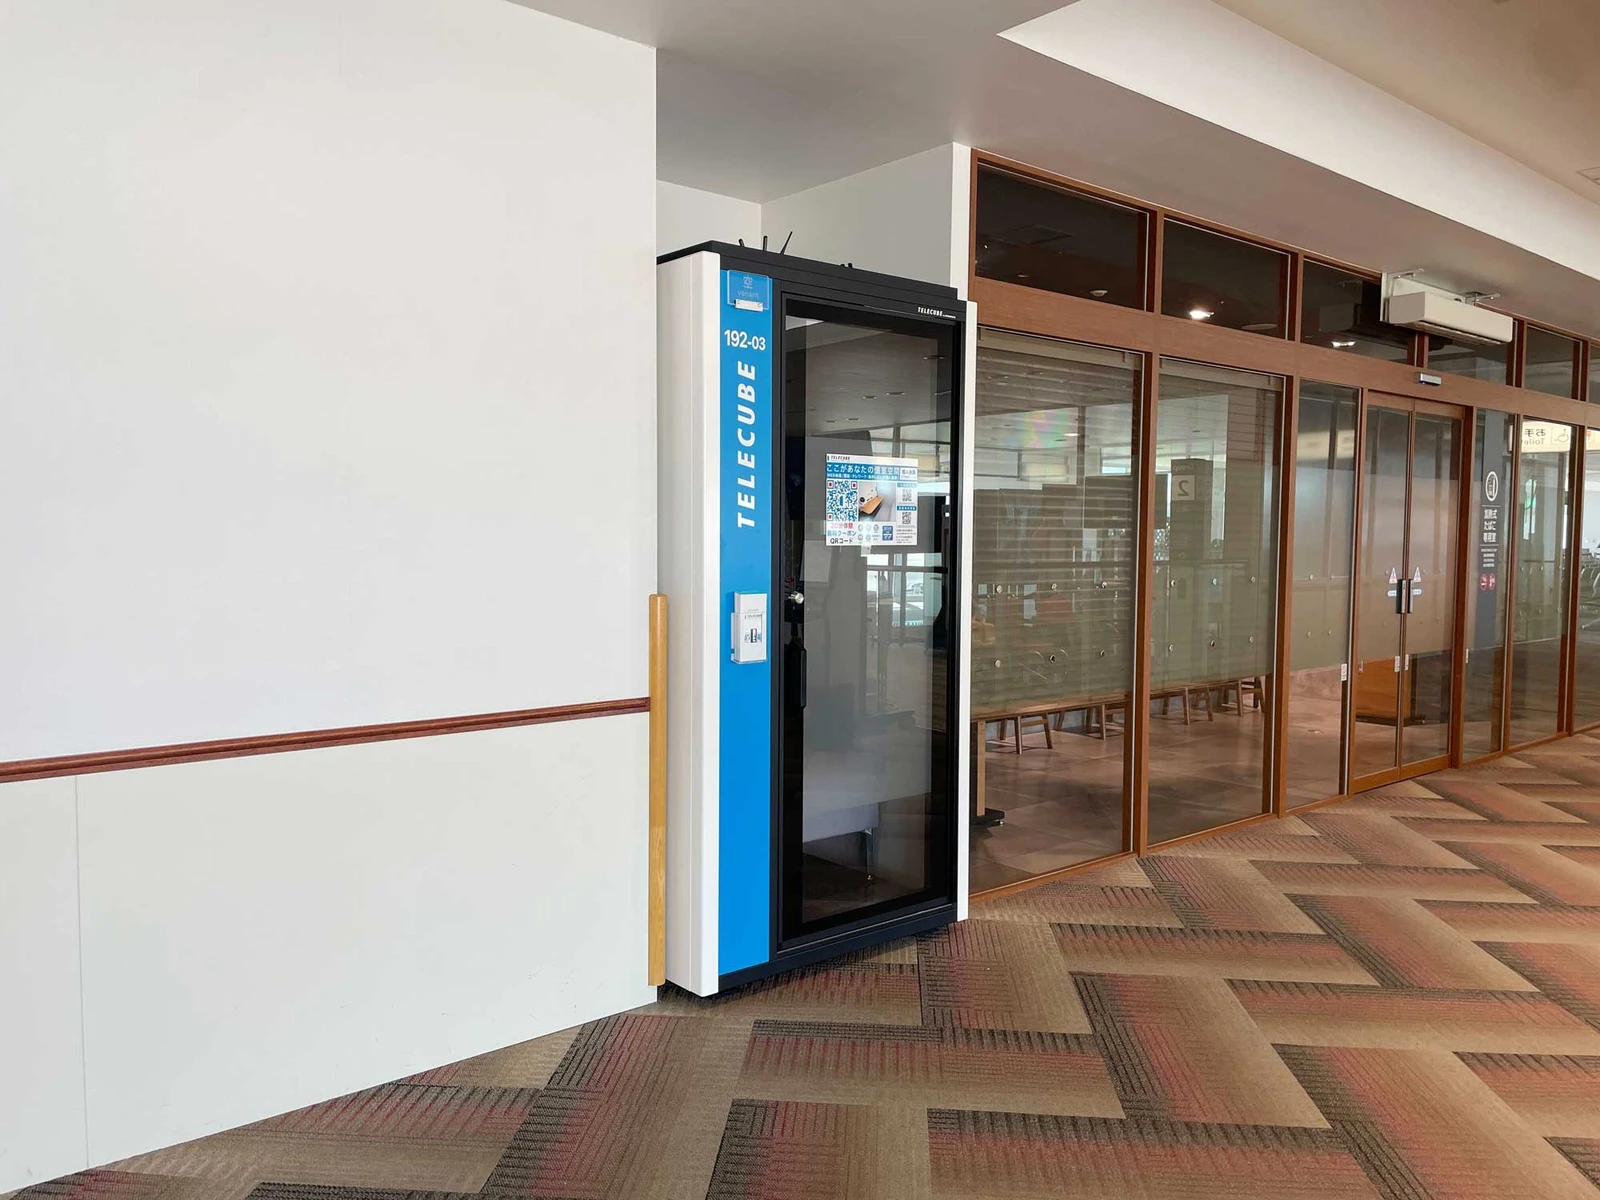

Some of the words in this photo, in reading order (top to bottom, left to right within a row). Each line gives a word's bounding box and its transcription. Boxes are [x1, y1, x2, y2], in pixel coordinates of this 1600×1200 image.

[917, 306, 943, 317] TELECUBE
[724, 329, 766, 351] 192-03
[737, 360, 756, 528] TELECUBE
